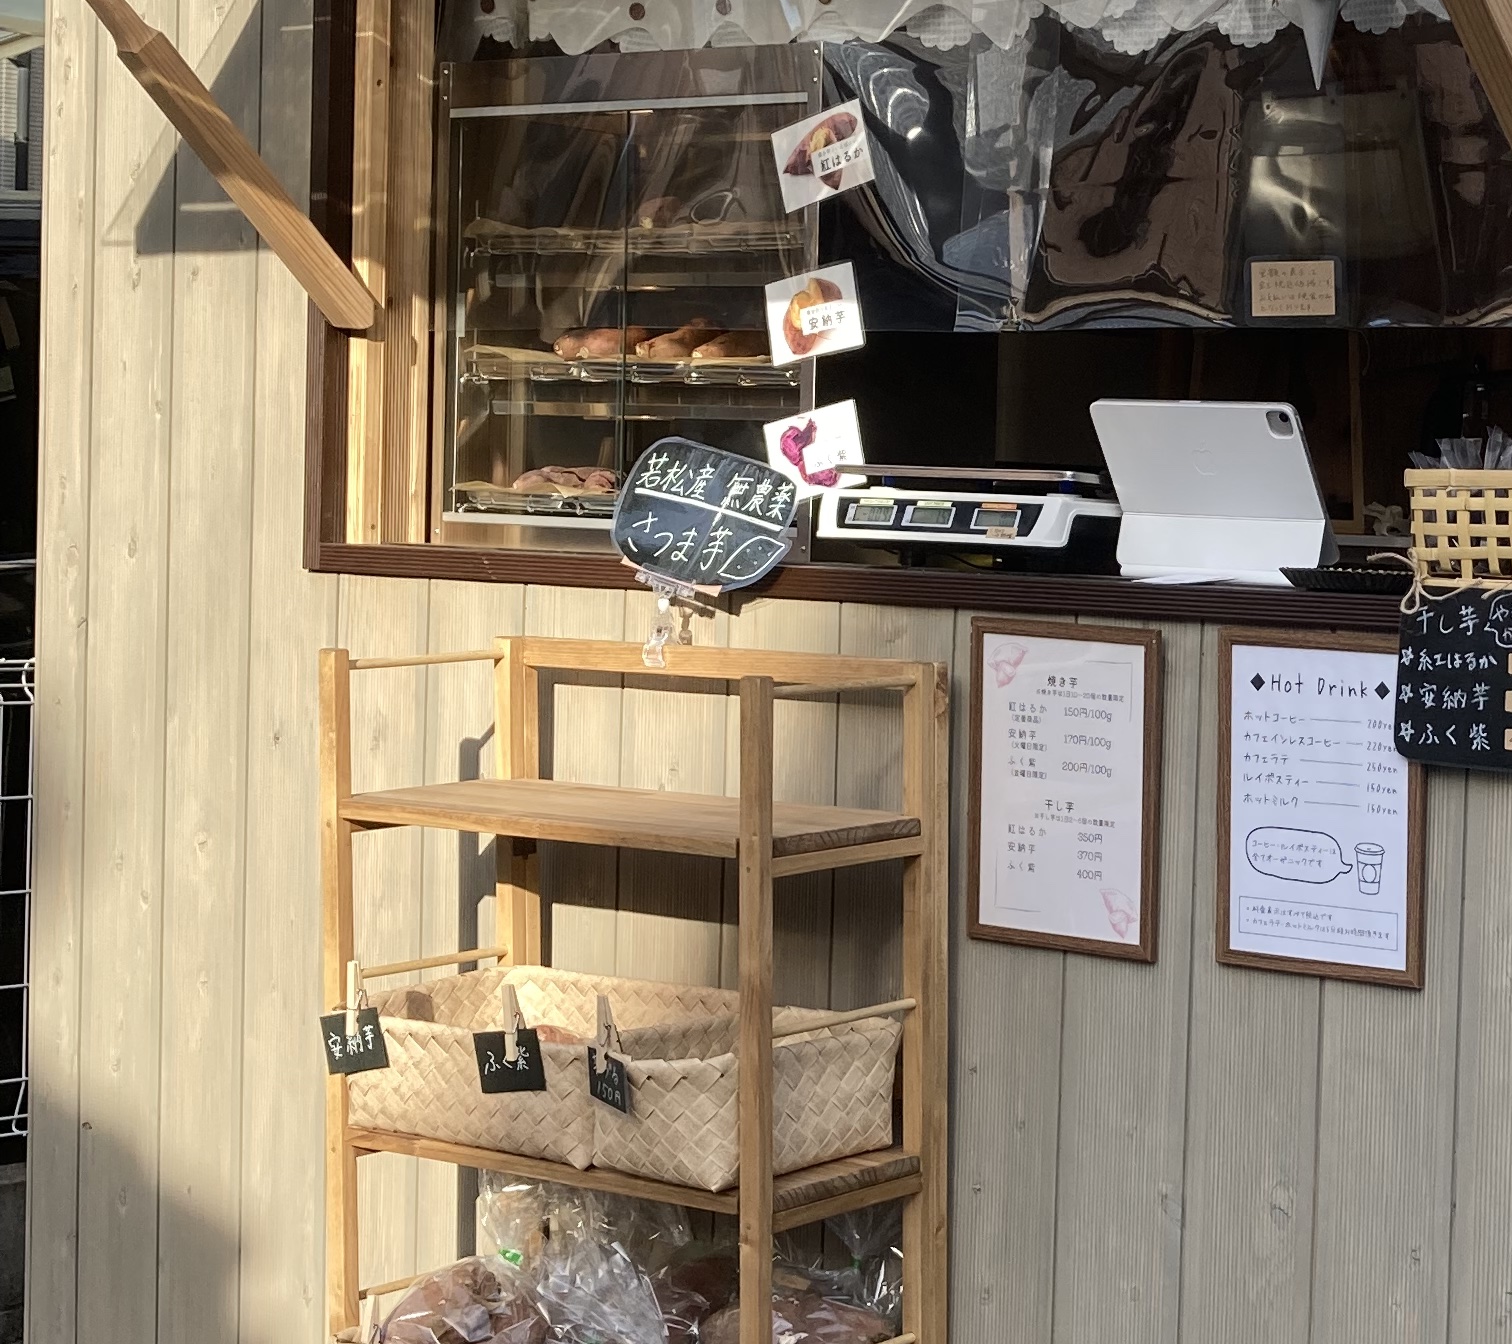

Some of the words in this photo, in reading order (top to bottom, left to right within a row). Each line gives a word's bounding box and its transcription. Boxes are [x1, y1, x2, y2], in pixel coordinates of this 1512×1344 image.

[636, 452, 715, 501] 若松産
[720, 472, 795, 521] 無農薬
[627, 511, 733, 571] さつま芋
[1416, 605, 1480, 636] 干し芋
[1417, 648, 1498, 672] 紅はるか
[1271, 673, 1304, 694] Hot
[1317, 677, 1368, 698] Drink
[1418, 682, 1491, 711] 安納芋
[1064, 707, 1112, 722] 150円/100g
[1244, 711, 1305, 724] ホットコーヒー
[1064, 734, 1112, 750] 170円/100g
[1244, 731, 1340, 748] カフェインレスコーヒー
[1418, 722, 1491, 751] ふく紫
[1244, 752, 1289, 765] カフェラテ
[1062, 761, 1112, 778] 200円/100g
[1045, 799, 1075, 813] 干し芋
[1243, 793, 1299, 808] ホットミルク
[1077, 832, 1103, 845] 350円
[1077, 850, 1103, 862] 370円
[1077, 869, 1103, 882] 400円
